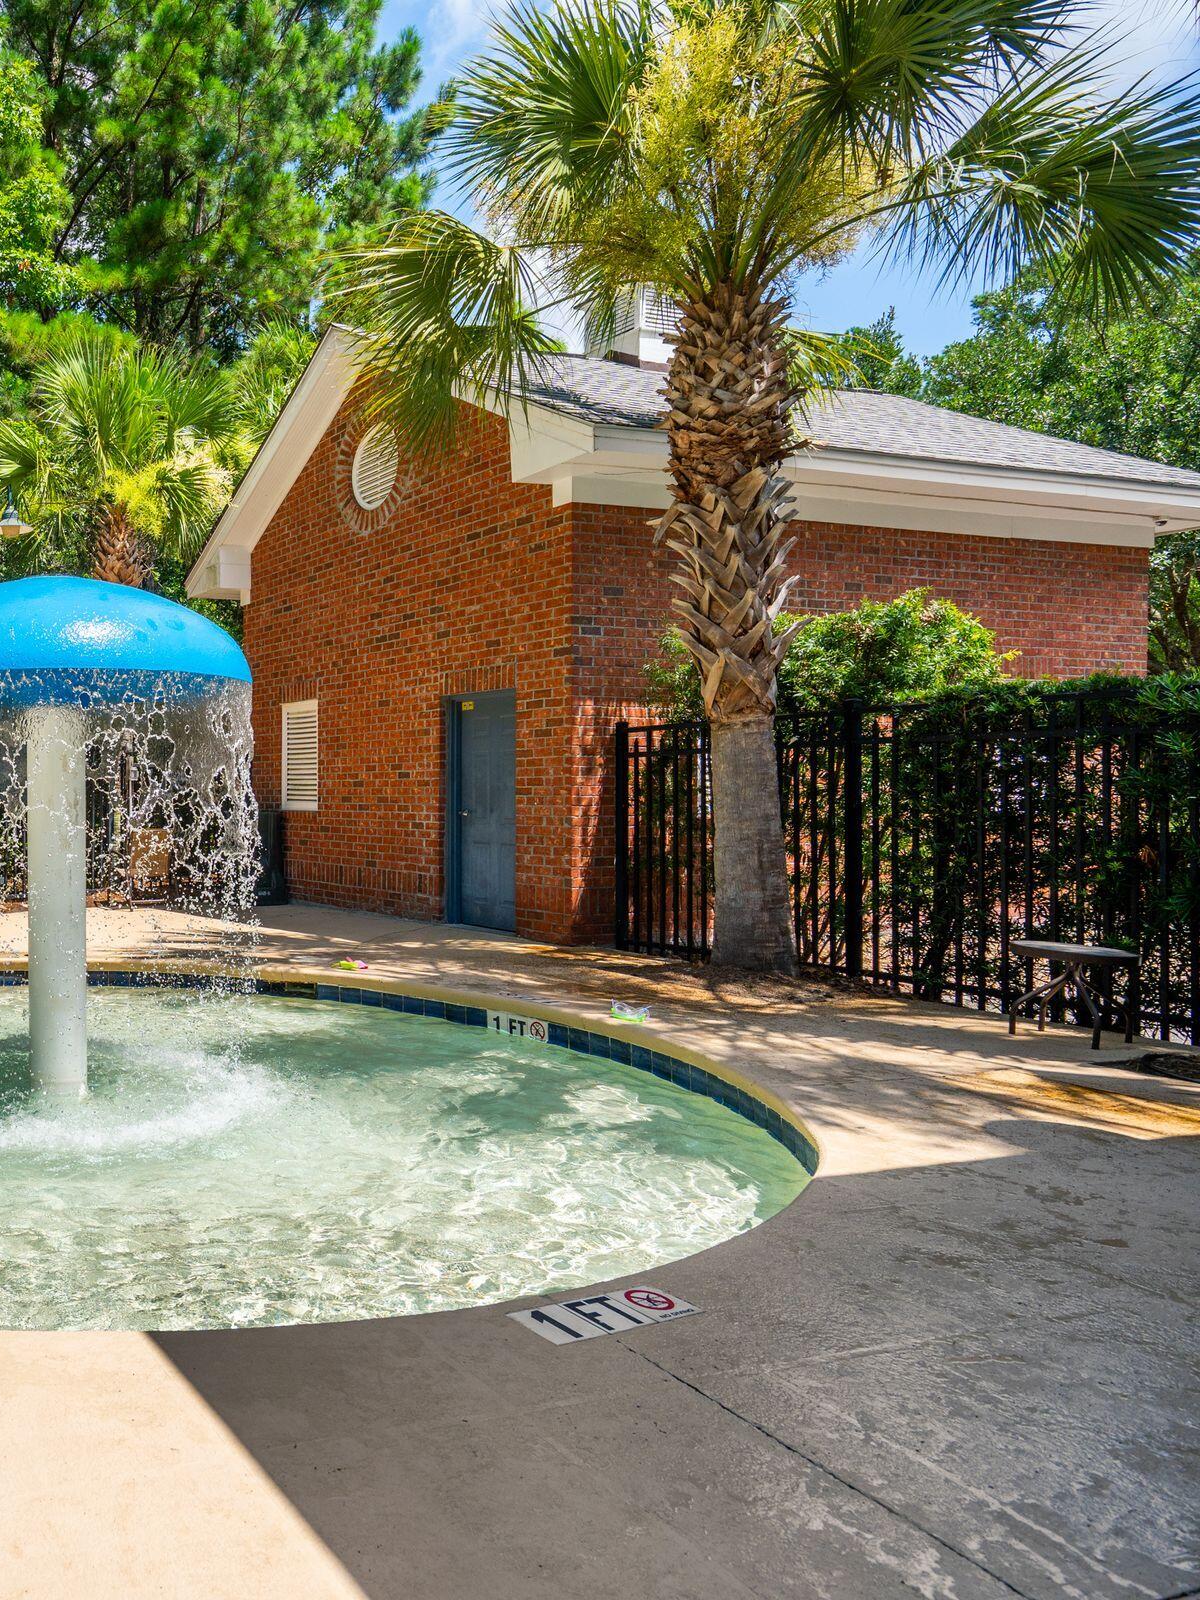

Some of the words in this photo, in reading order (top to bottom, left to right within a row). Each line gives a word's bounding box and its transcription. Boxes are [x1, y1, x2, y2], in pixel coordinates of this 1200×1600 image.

[492, 1016, 500, 1030] 1
[508, 1018, 527, 1036] FT
[530, 1310, 584, 1339] 1
[563, 1296, 644, 1331] FT
